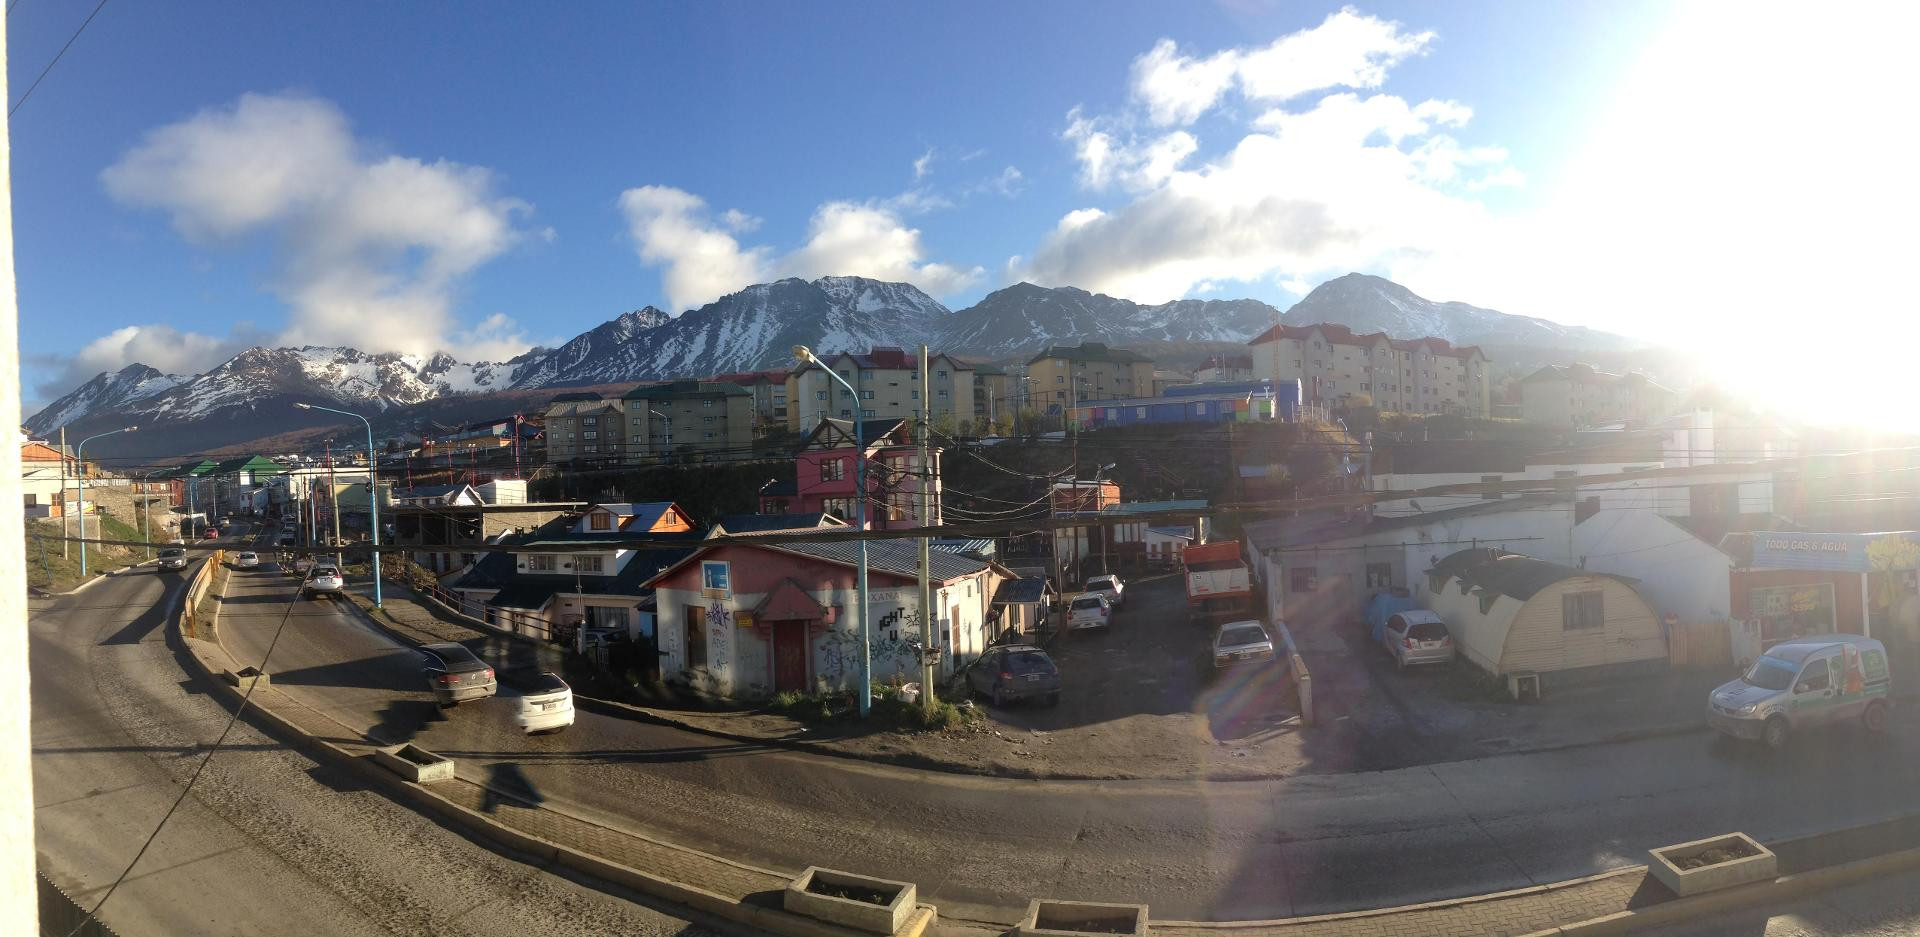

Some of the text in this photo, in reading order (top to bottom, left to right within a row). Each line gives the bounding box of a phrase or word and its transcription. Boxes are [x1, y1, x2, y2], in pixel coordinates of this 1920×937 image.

[1766, 539, 1789, 550] TODO
[1791, 540, 1809, 550] GAS
[1821, 541, 1848, 552] AGUA
